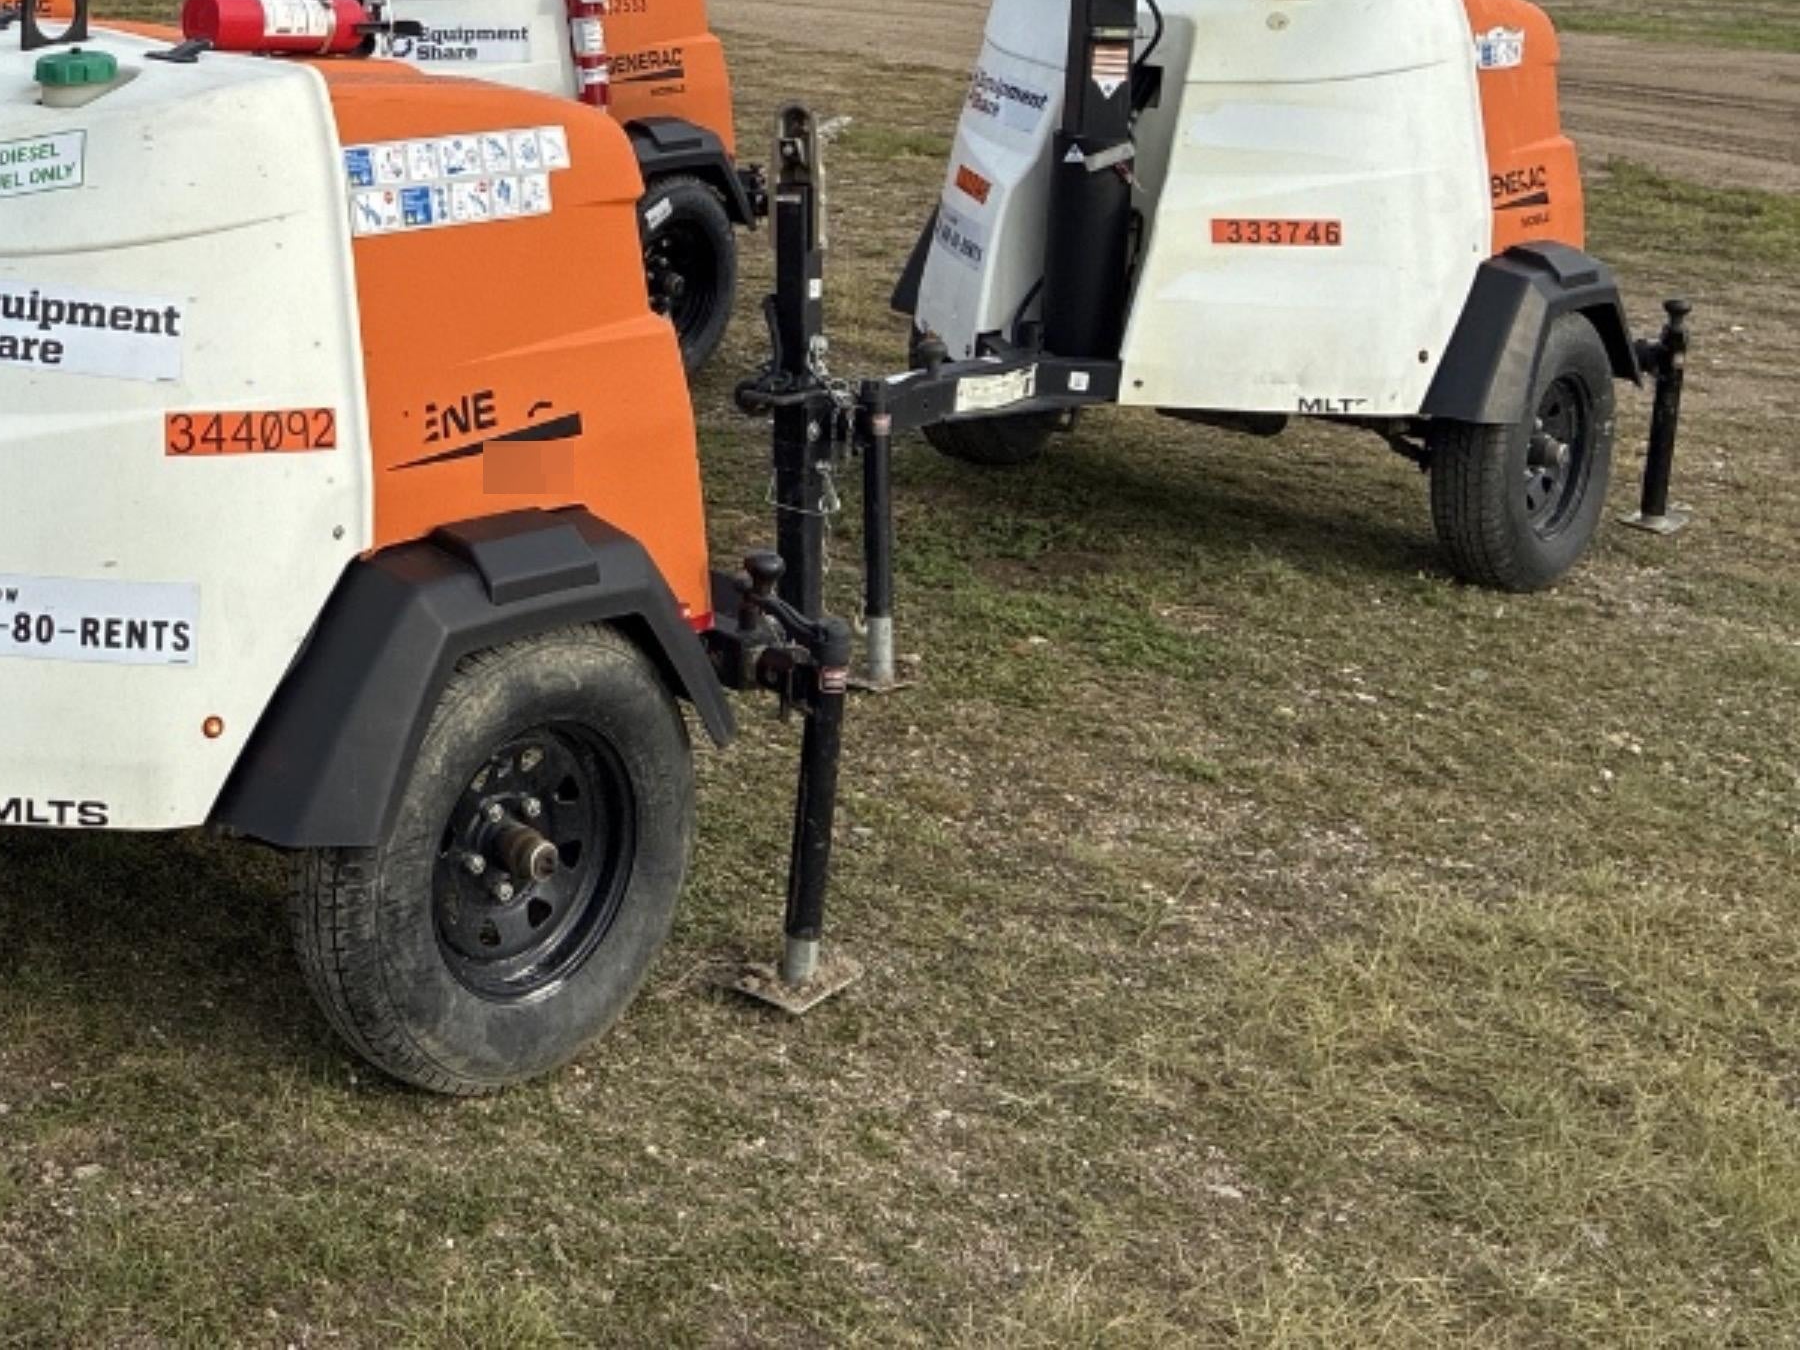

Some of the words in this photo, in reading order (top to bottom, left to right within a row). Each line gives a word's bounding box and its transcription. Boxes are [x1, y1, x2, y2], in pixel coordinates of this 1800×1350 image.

[416, 45, 478, 61] Share
[28, 160, 77, 186] ONLY
[1226, 220, 1341, 245] 333746
[168, 408, 336, 454] 344092
